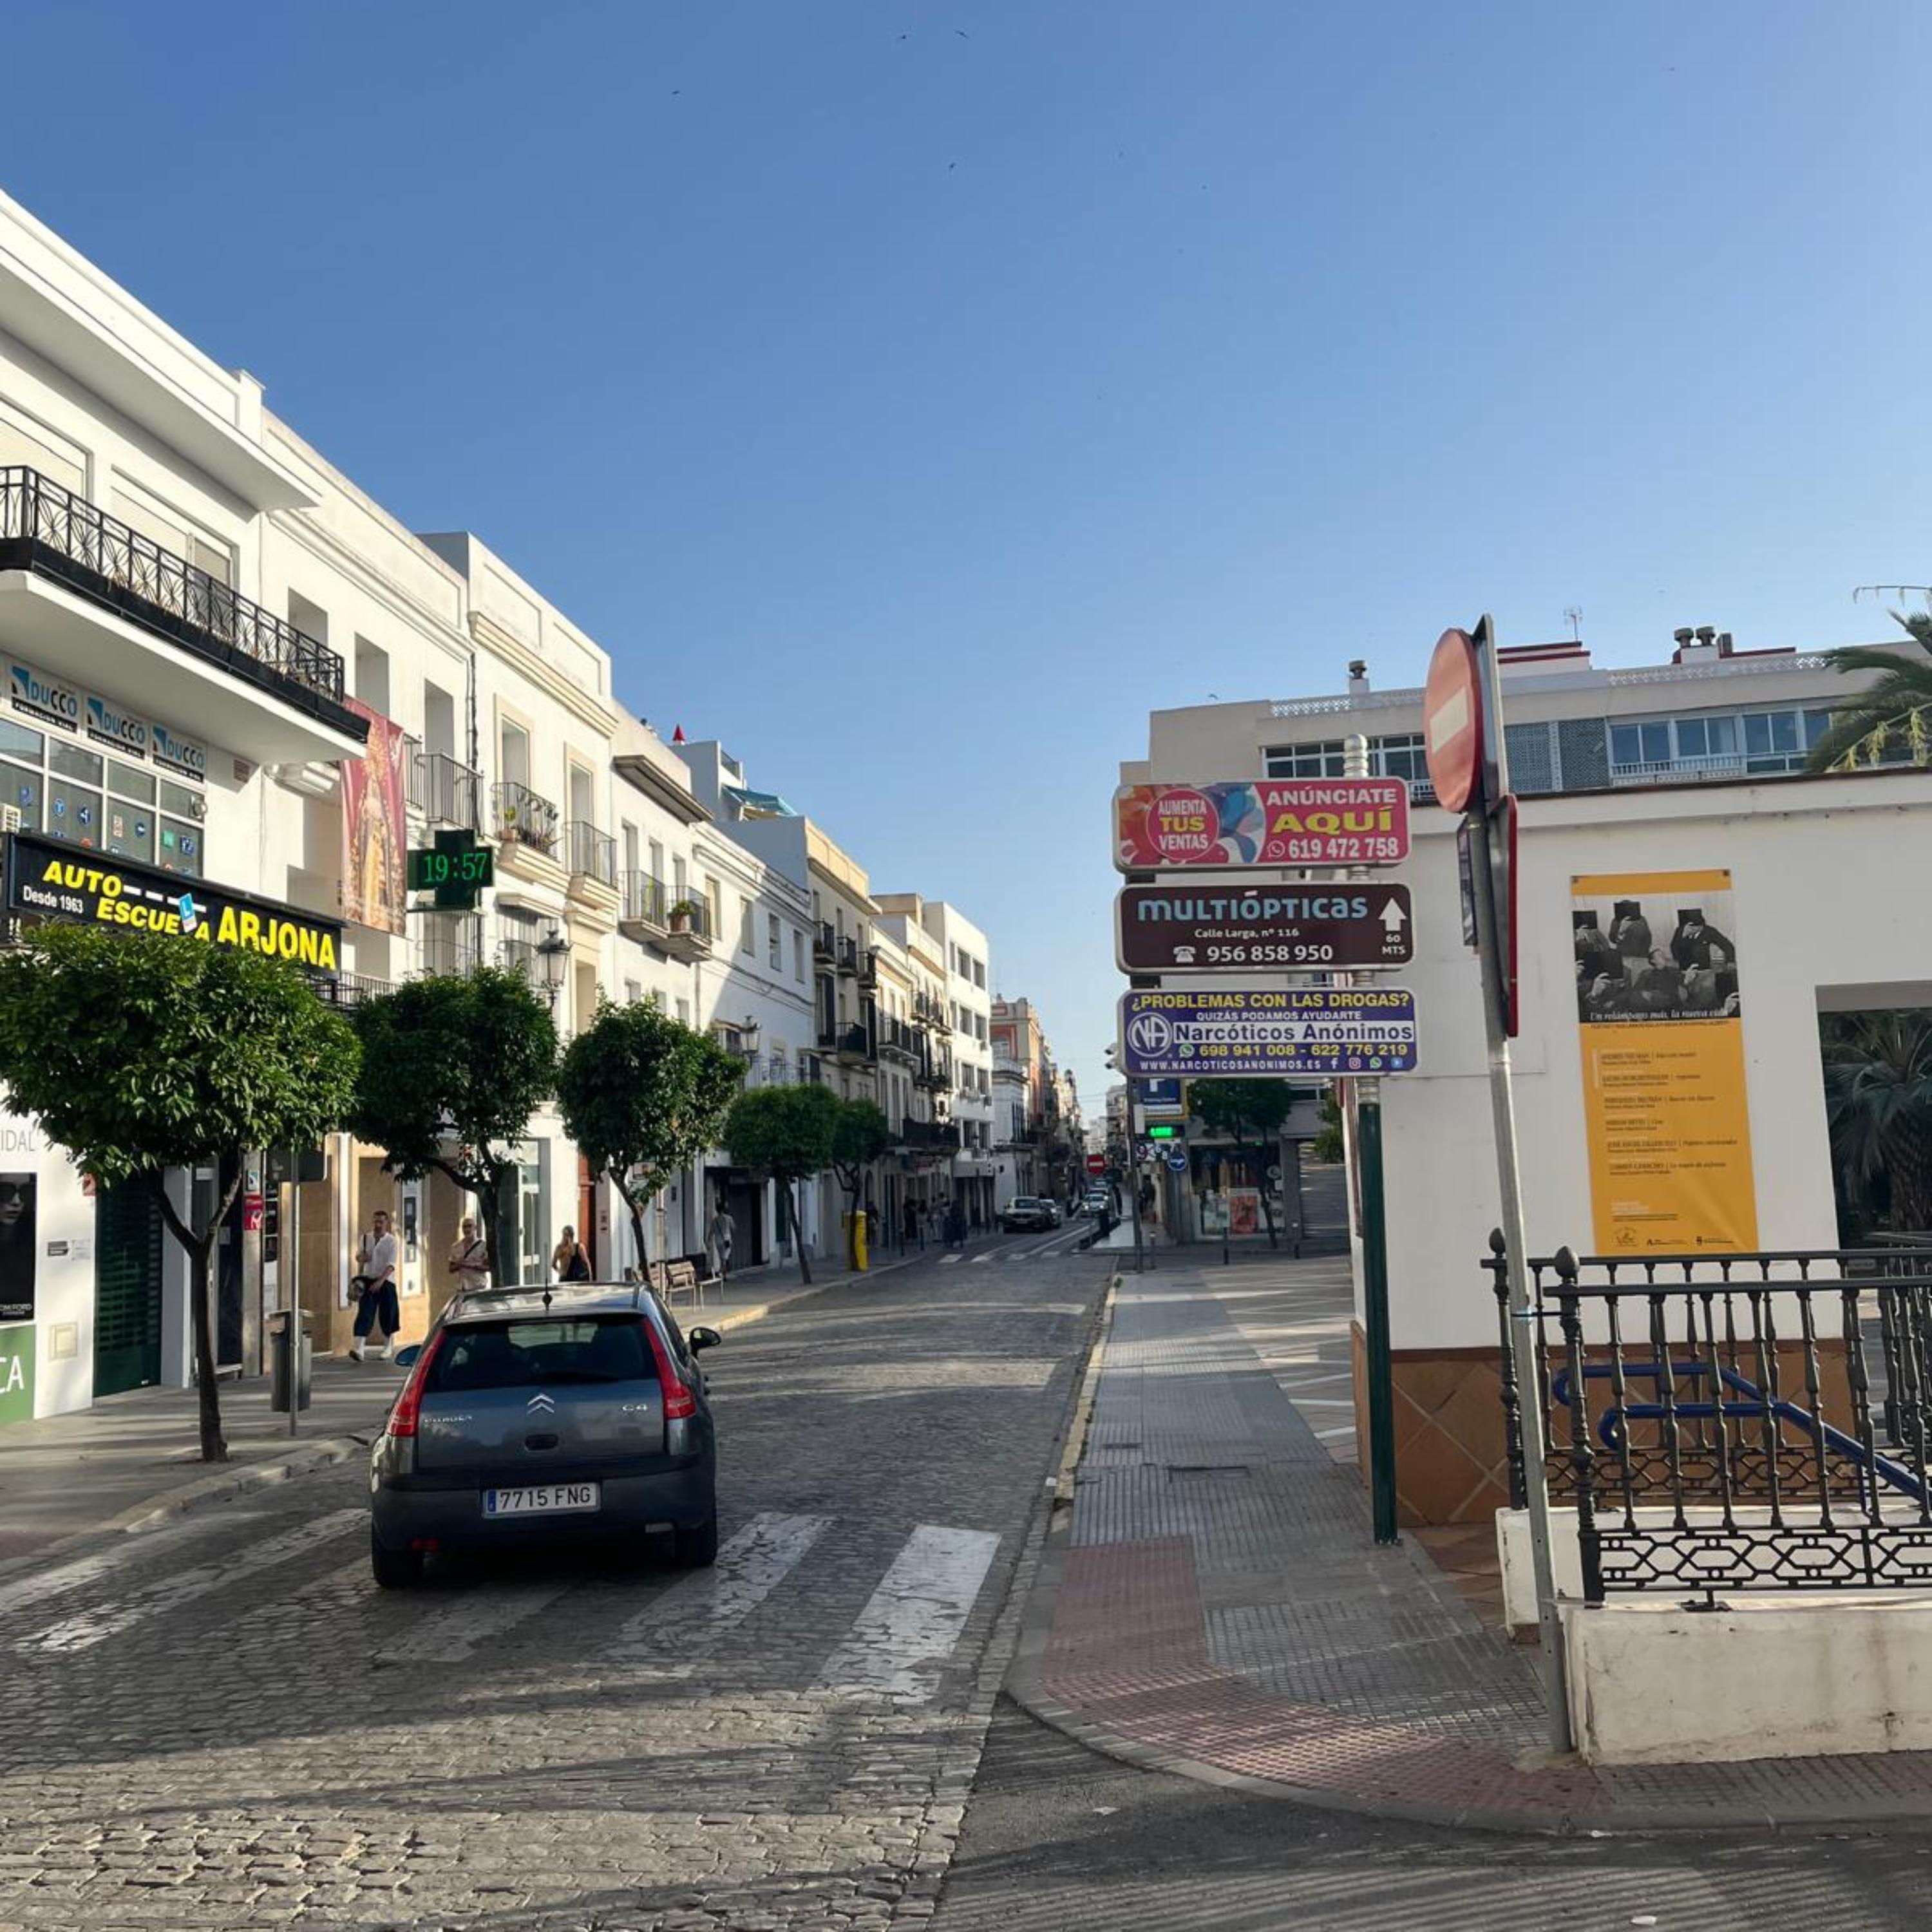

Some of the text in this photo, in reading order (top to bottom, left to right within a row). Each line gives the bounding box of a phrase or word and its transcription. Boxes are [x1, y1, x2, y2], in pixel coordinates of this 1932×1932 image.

[32, 683, 77, 716] DUCCO
[104, 715, 145, 744] DUCCO
[167, 740, 204, 768] DUCCO
[1267, 785, 1397, 805] ANÚNCIATE
[1158, 799, 1206, 815] AUMENTA
[1160, 816, 1204, 832] TUS
[1272, 805, 1393, 835] AQUÍ
[1159, 833, 1208, 850] VENTAS
[1289, 837, 1398, 858] 619 472 758
[423, 853, 487, 882] 19:57
[42, 860, 122, 897] AUTO
[23, 885, 83, 914] Desde 1963
[217, 905, 336, 970] ARJONA
[1194, 929, 1222, 938] Calle
[1278, 927, 1300, 937] 116
[1386, 934, 1401, 942] 60
[1207, 945, 1333, 961] 956 858 950
[1382, 945, 1406, 954] MTS
[1132, 993, 1409, 1011] ¿PROBLEMAS CON LAS DROGAS?
[1196, 1010, 1362, 1021] QUIZÁS PODAMOS AYUDARTE
[1176, 1023, 1413, 1041] Narcóticos Anónimos
[1199, 1044, 1228, 1056] 698
[1233, 1045, 1260, 1056] 941
[1266, 1044, 1295, 1056] 008
[1311, 1044, 1340, 1056] 622
[1345, 1044, 1374, 1055] 776
[1378, 1043, 1408, 1056] 219
[1140, 1059, 1321, 1070] WWW.NARCOTICOSANONIMOS.ES
[500, 1486, 591, 1510] 7715 FNG
